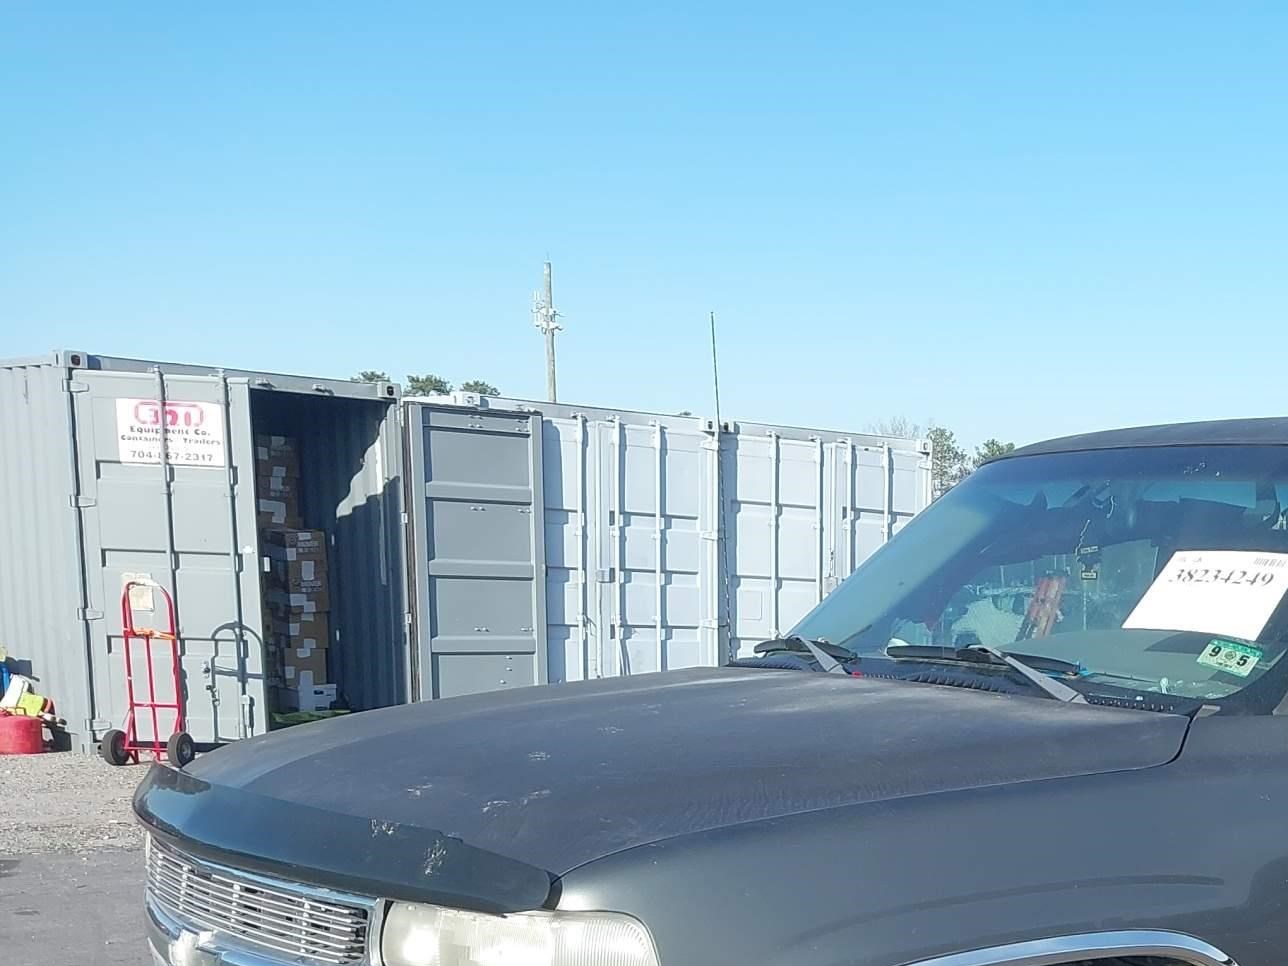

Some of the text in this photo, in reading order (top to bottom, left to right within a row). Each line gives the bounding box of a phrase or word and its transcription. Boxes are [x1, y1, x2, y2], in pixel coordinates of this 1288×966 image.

[194, 428, 211, 436] Co.
[1168, 569, 1275, 586] 38234249
[1209, 646, 1222, 657] 9
[1236, 654, 1250, 667] 5
